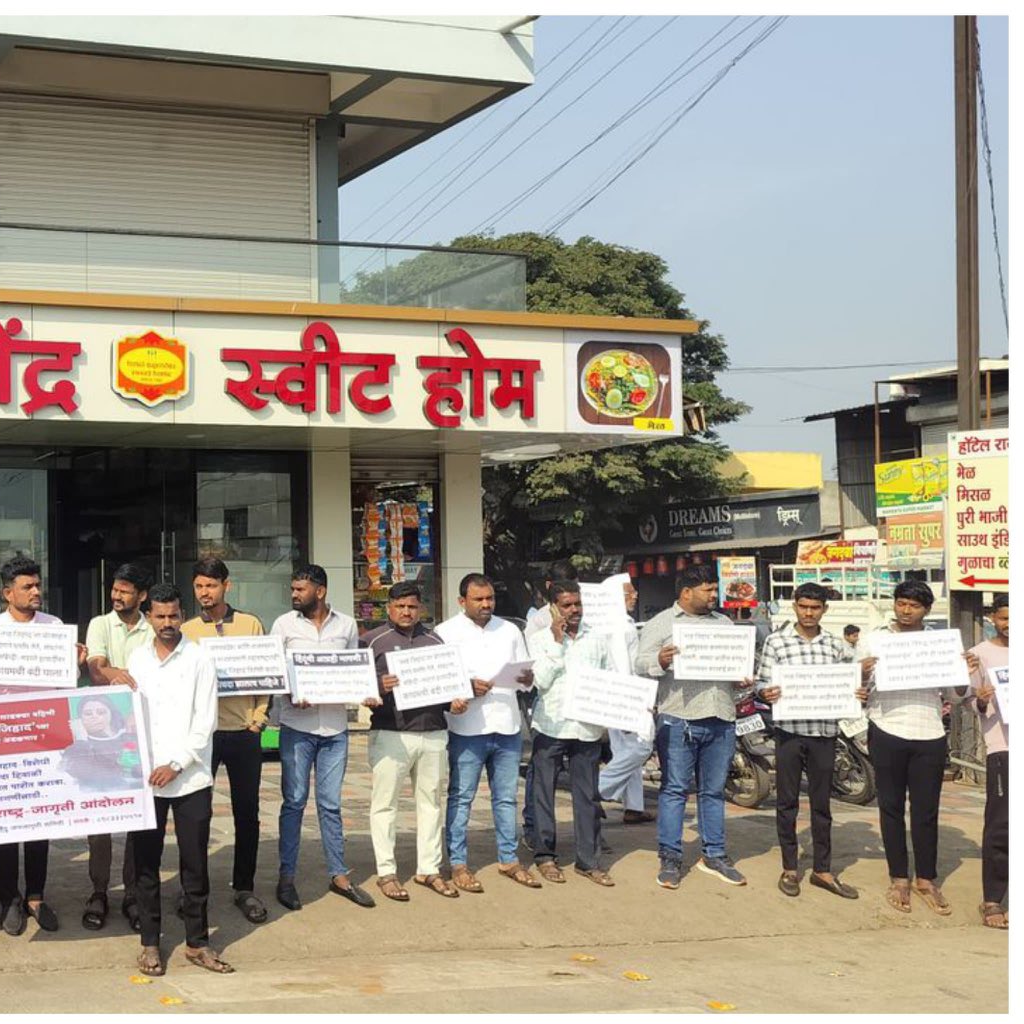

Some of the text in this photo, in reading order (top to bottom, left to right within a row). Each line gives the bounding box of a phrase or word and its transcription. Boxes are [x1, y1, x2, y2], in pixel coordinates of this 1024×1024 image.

[220, 322, 395, 415] स्वीट
[418, 327, 540, 428] होम
[958, 436, 990, 454] हॉटेल
[957, 463, 975, 479] भेळ
[957, 486, 990, 501] मिसळ
[668, 505, 731, 526] DREAMS
[957, 505, 1007, 529] पुरी भाजी
[918, 523, 942, 547] सुपर
[957, 534, 987, 546] साउथ
[958, 556, 994, 574] गुळाचा
[80, 797, 135, 811] आंदोलन
